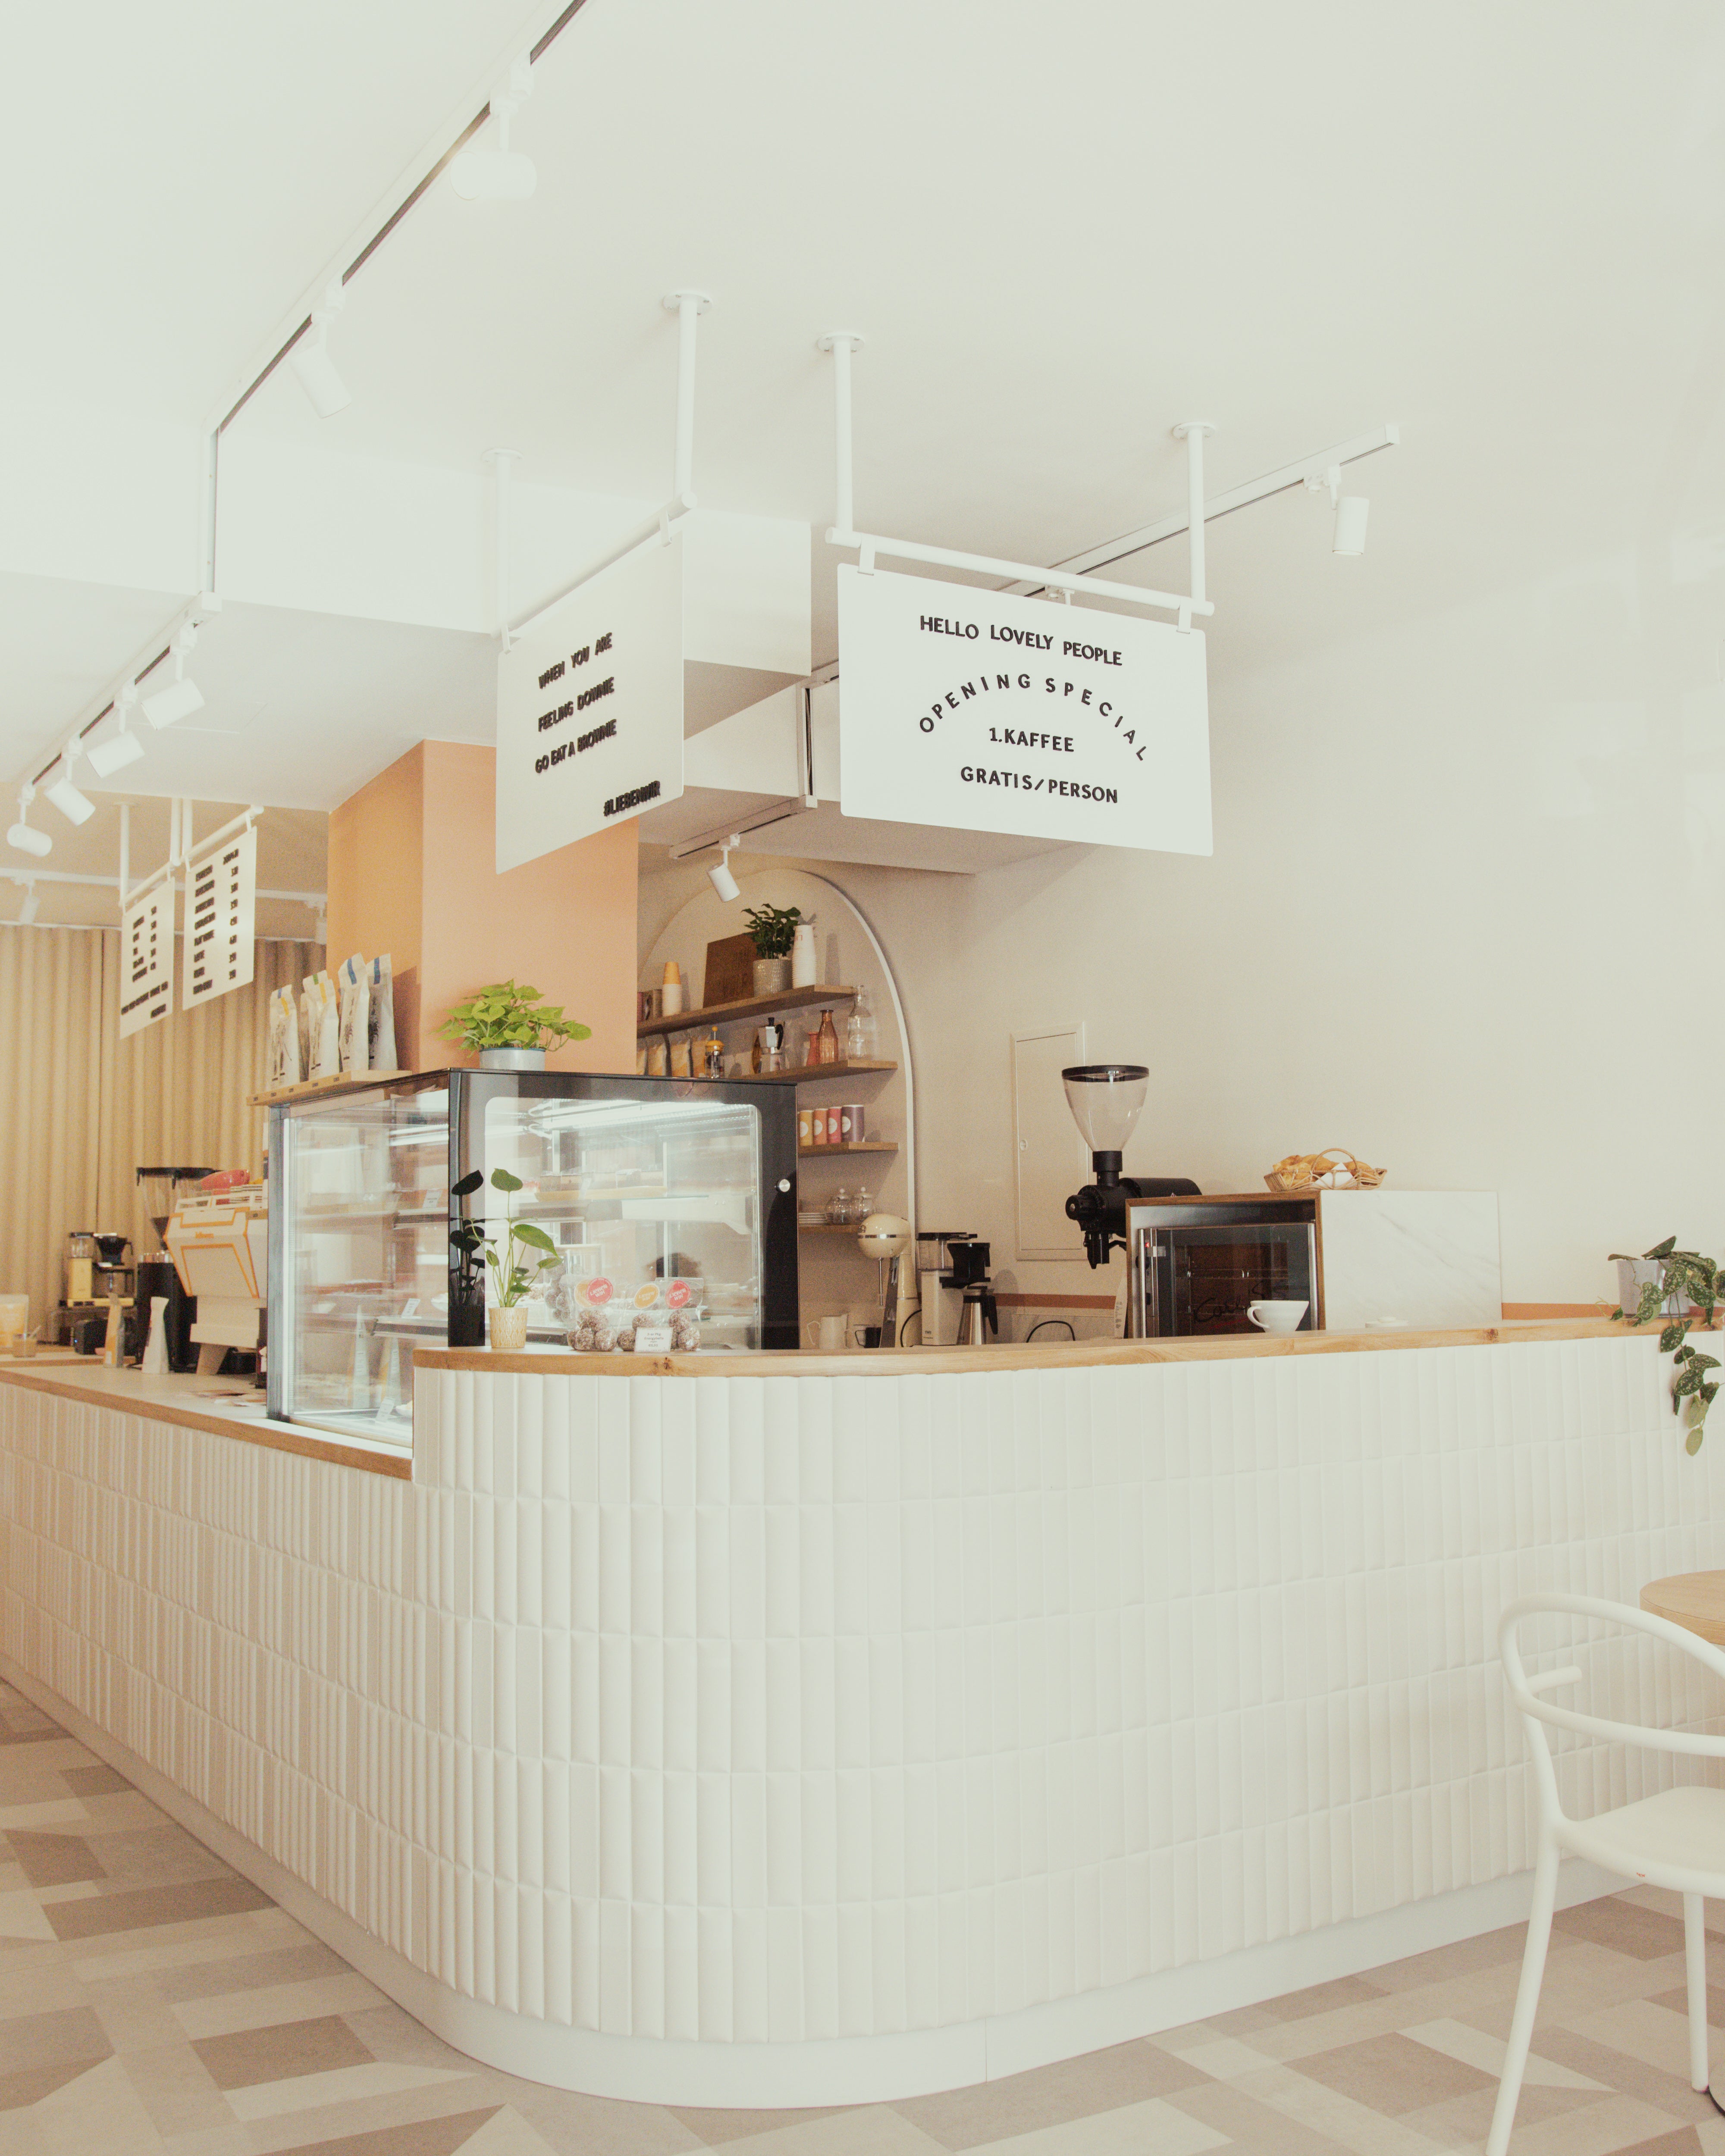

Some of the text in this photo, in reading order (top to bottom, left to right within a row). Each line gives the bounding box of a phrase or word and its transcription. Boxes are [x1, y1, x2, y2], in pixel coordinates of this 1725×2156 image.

[538, 632, 612, 689] WHEN YOU ARE
[920, 615, 1123, 666] HELLO LOVELY PEOPLE
[538, 677, 615, 732] FEELING DOWNIE
[919, 674, 1146, 761] OPENING SPECIAL
[535, 719, 617, 774] GO EAT A BROWNIE
[989, 727, 1074, 752] 1.KAFFEE
[603, 780, 661, 817] #LIEBENWIR
[960, 766, 1118, 804] GRATIS/PERSON
